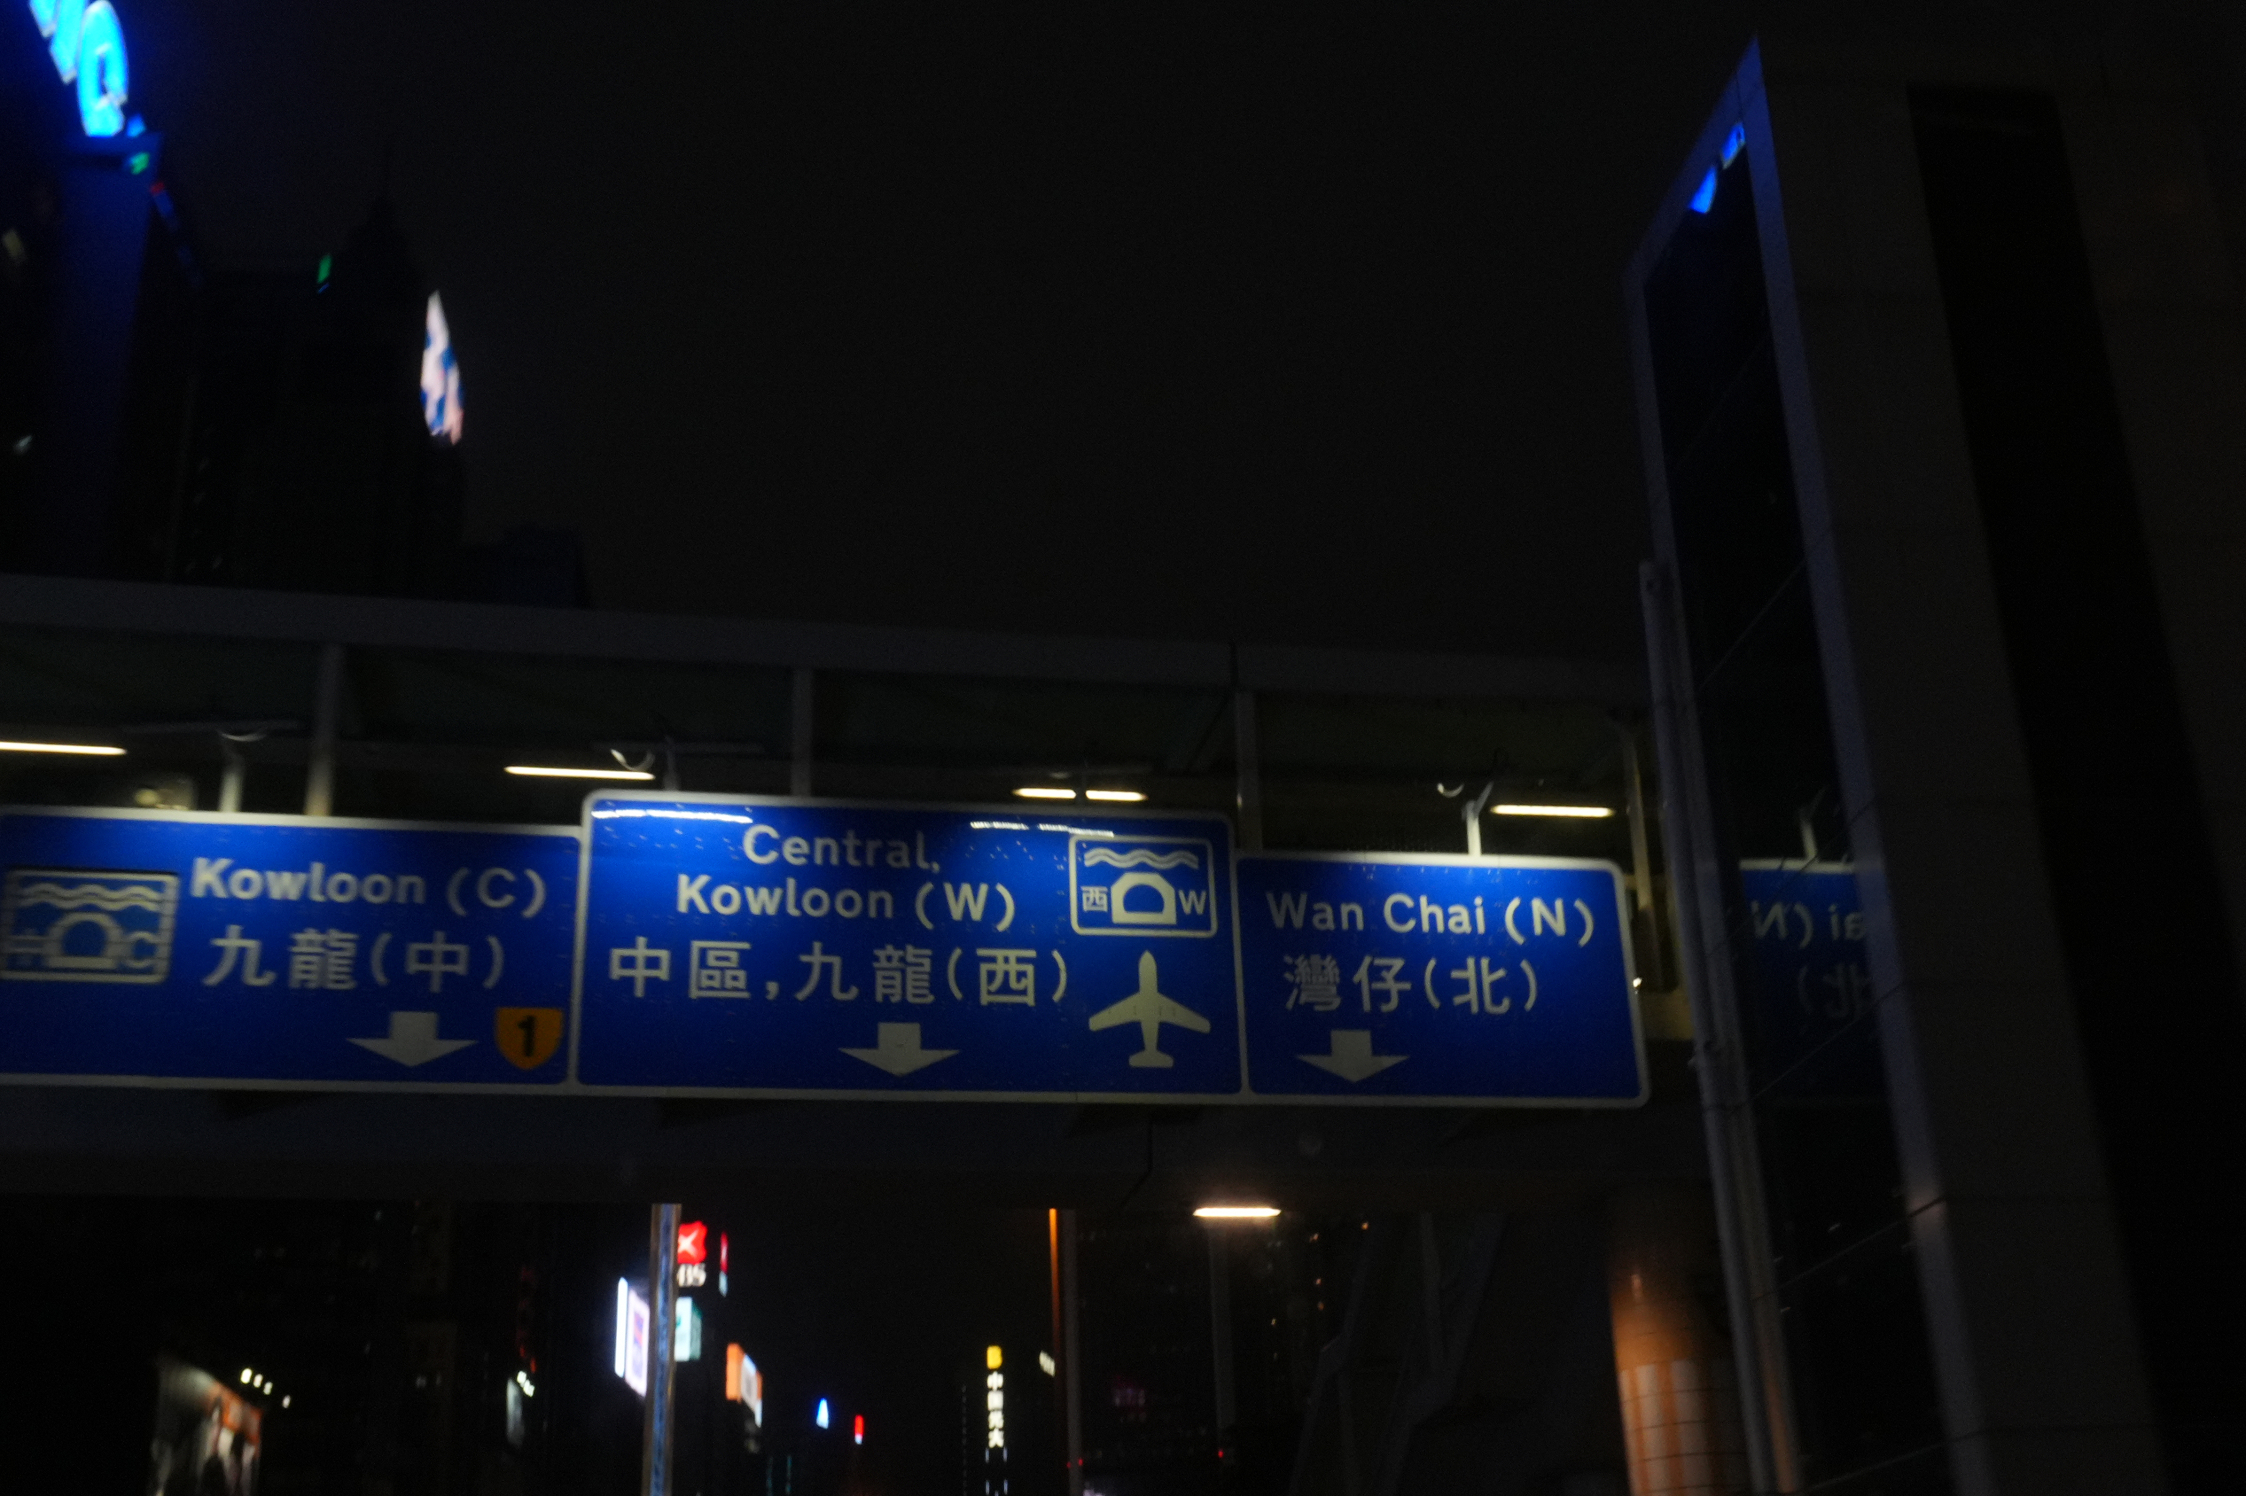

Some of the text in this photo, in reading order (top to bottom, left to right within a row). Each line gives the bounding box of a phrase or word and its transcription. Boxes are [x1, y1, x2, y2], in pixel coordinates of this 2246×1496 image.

[742, 823, 941, 873] Central,
[191, 857, 547, 918] Kowloon (C)
[676, 874, 1016, 932] Kowloon (W)
[1080, 886, 1111, 914] 西
[1180, 889, 1208, 916] W
[1267, 891, 1595, 947] Wan Chai (N)
[202, 924, 505, 993] 九龍(中)
[608, 935, 1068, 1007] 中區,九龍(西)
[1284, 953, 1539, 1015] 灣仔(北)
[517, 1016, 537, 1057] 1
